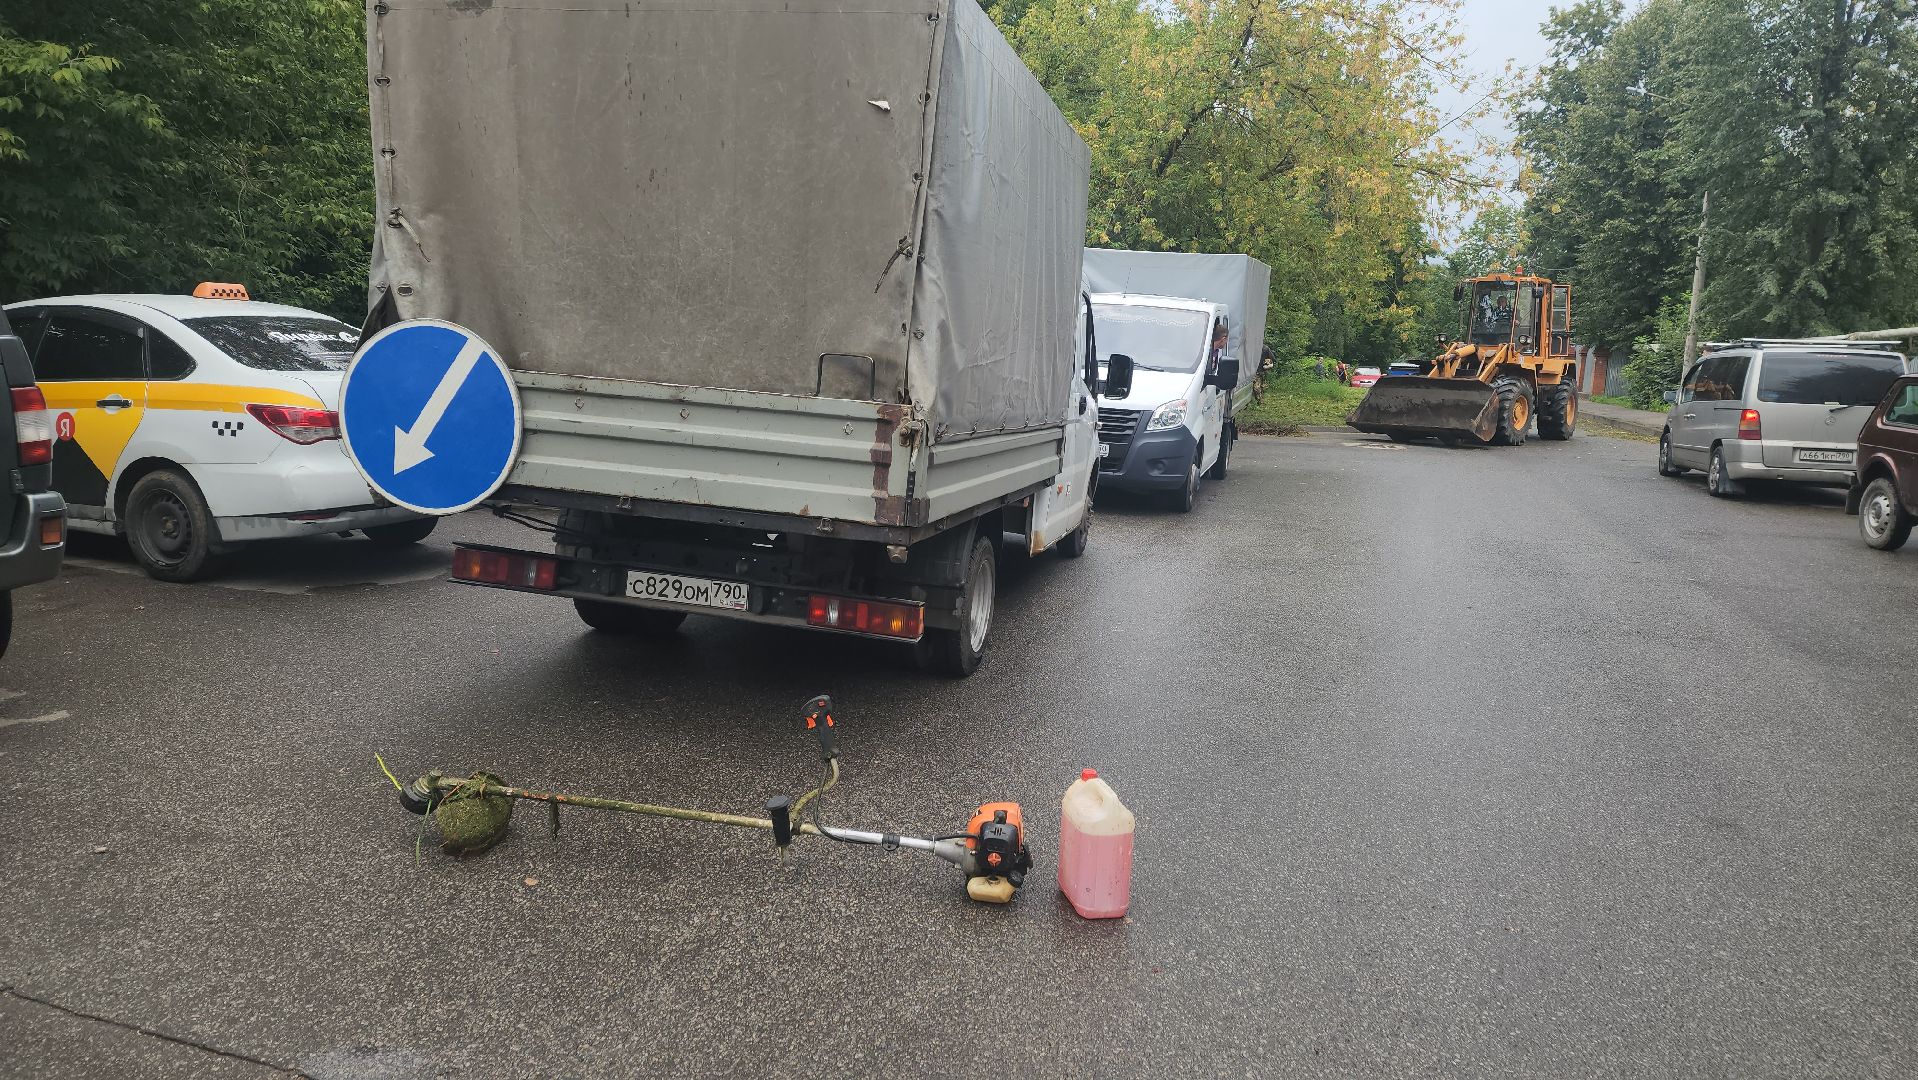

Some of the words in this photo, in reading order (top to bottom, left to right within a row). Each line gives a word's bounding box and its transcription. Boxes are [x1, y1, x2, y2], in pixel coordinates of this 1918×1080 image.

[61, 418, 70, 437] Я
[632, 576, 709, 602] С829ОМ
[713, 582, 742, 600] 790
